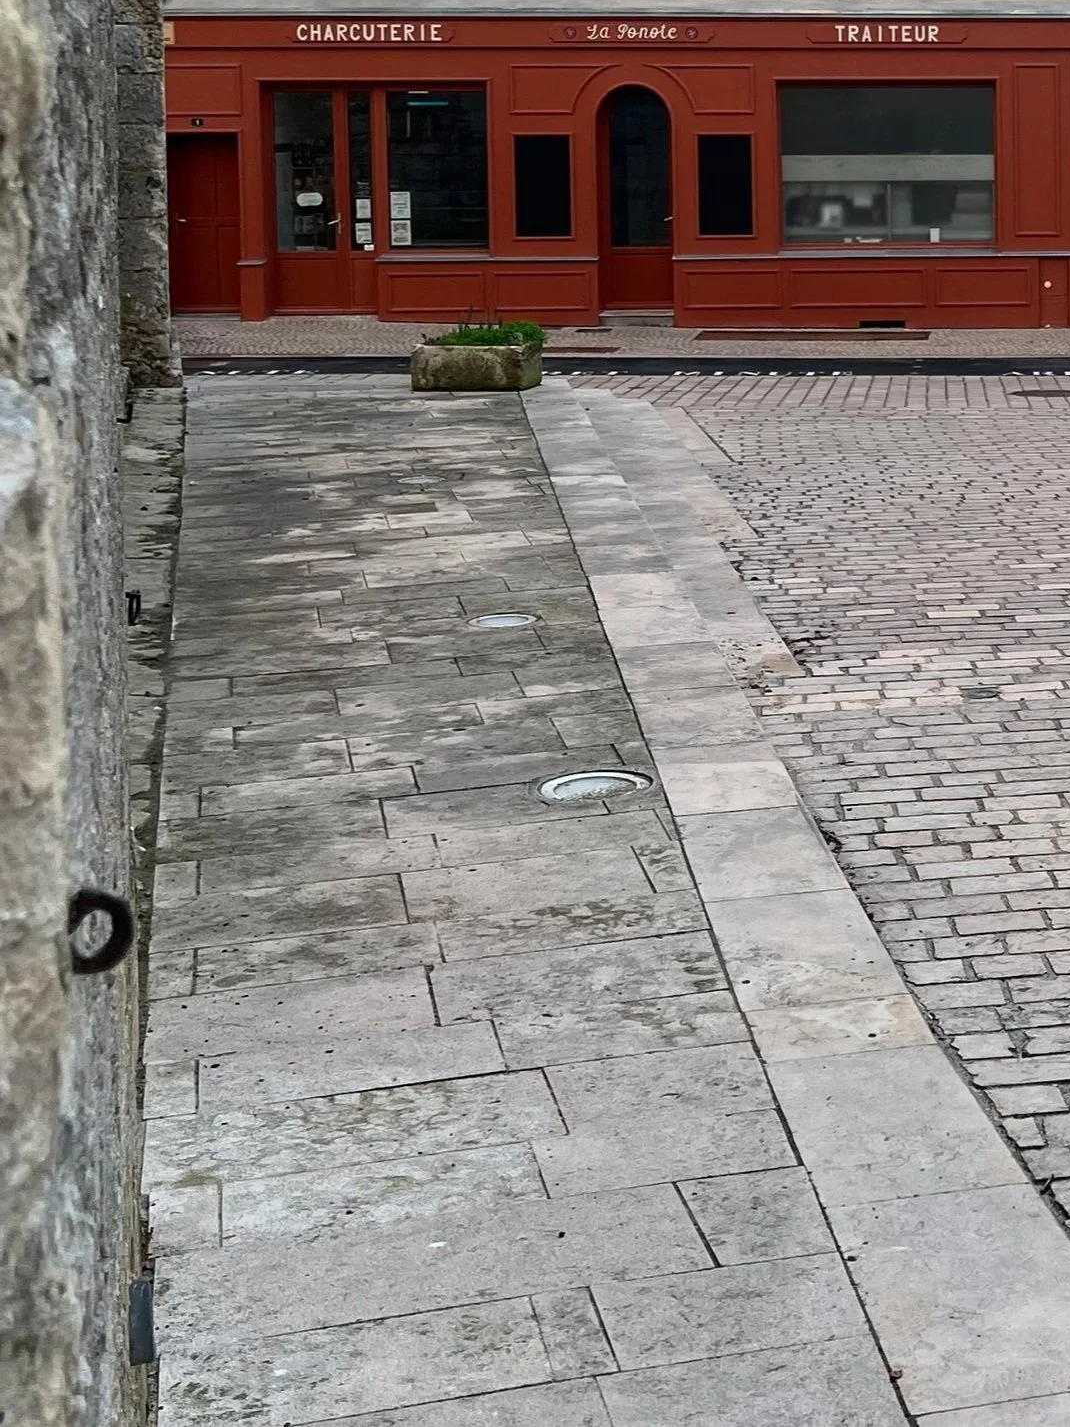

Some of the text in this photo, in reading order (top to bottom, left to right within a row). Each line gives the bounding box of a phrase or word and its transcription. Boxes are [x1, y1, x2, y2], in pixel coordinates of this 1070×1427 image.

[296, 24, 442, 41] CHARCUTERIE
[586, 23, 678, 40] La Ponote
[834, 25, 940, 42] TRAITEUR
